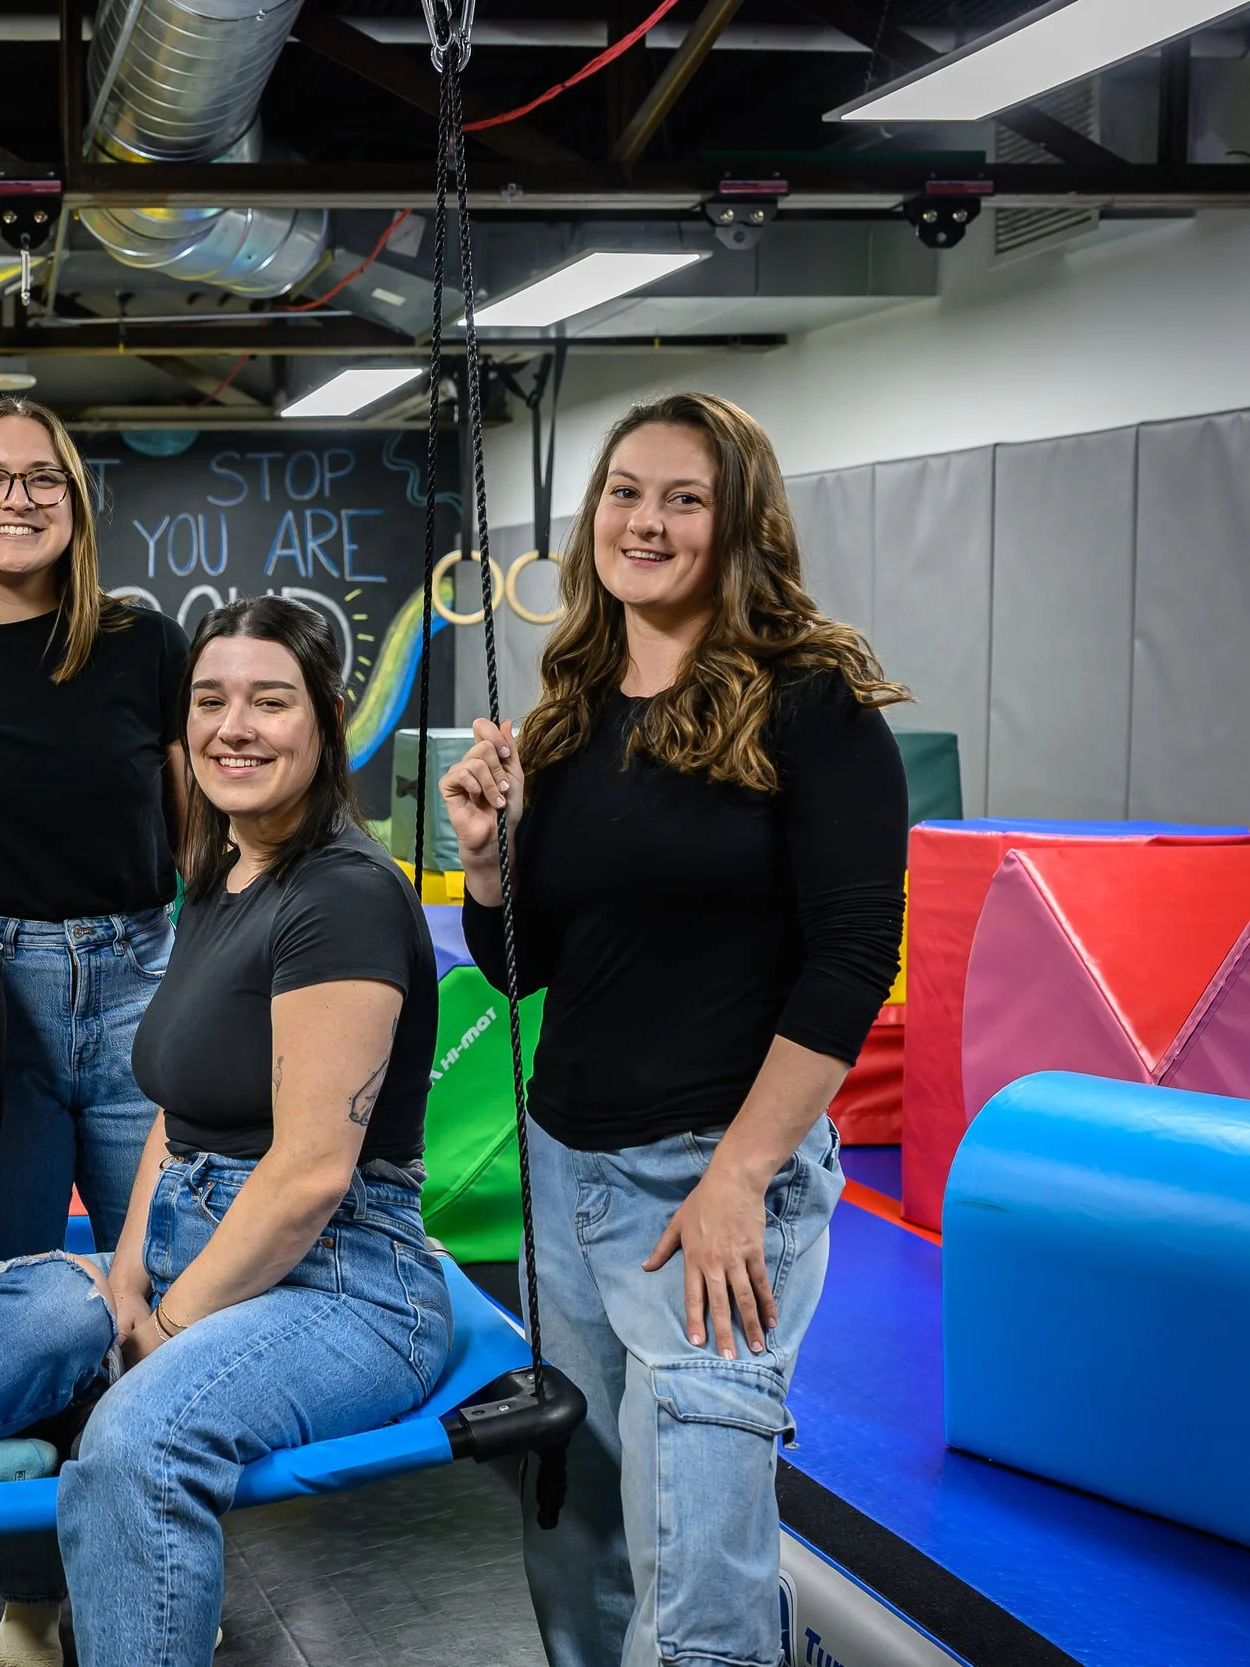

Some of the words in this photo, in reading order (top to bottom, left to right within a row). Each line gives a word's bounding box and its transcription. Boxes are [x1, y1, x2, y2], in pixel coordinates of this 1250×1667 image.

[206, 450, 356, 507] STOP
[132, 511, 229, 578] YOU
[263, 508, 388, 583] ARE
